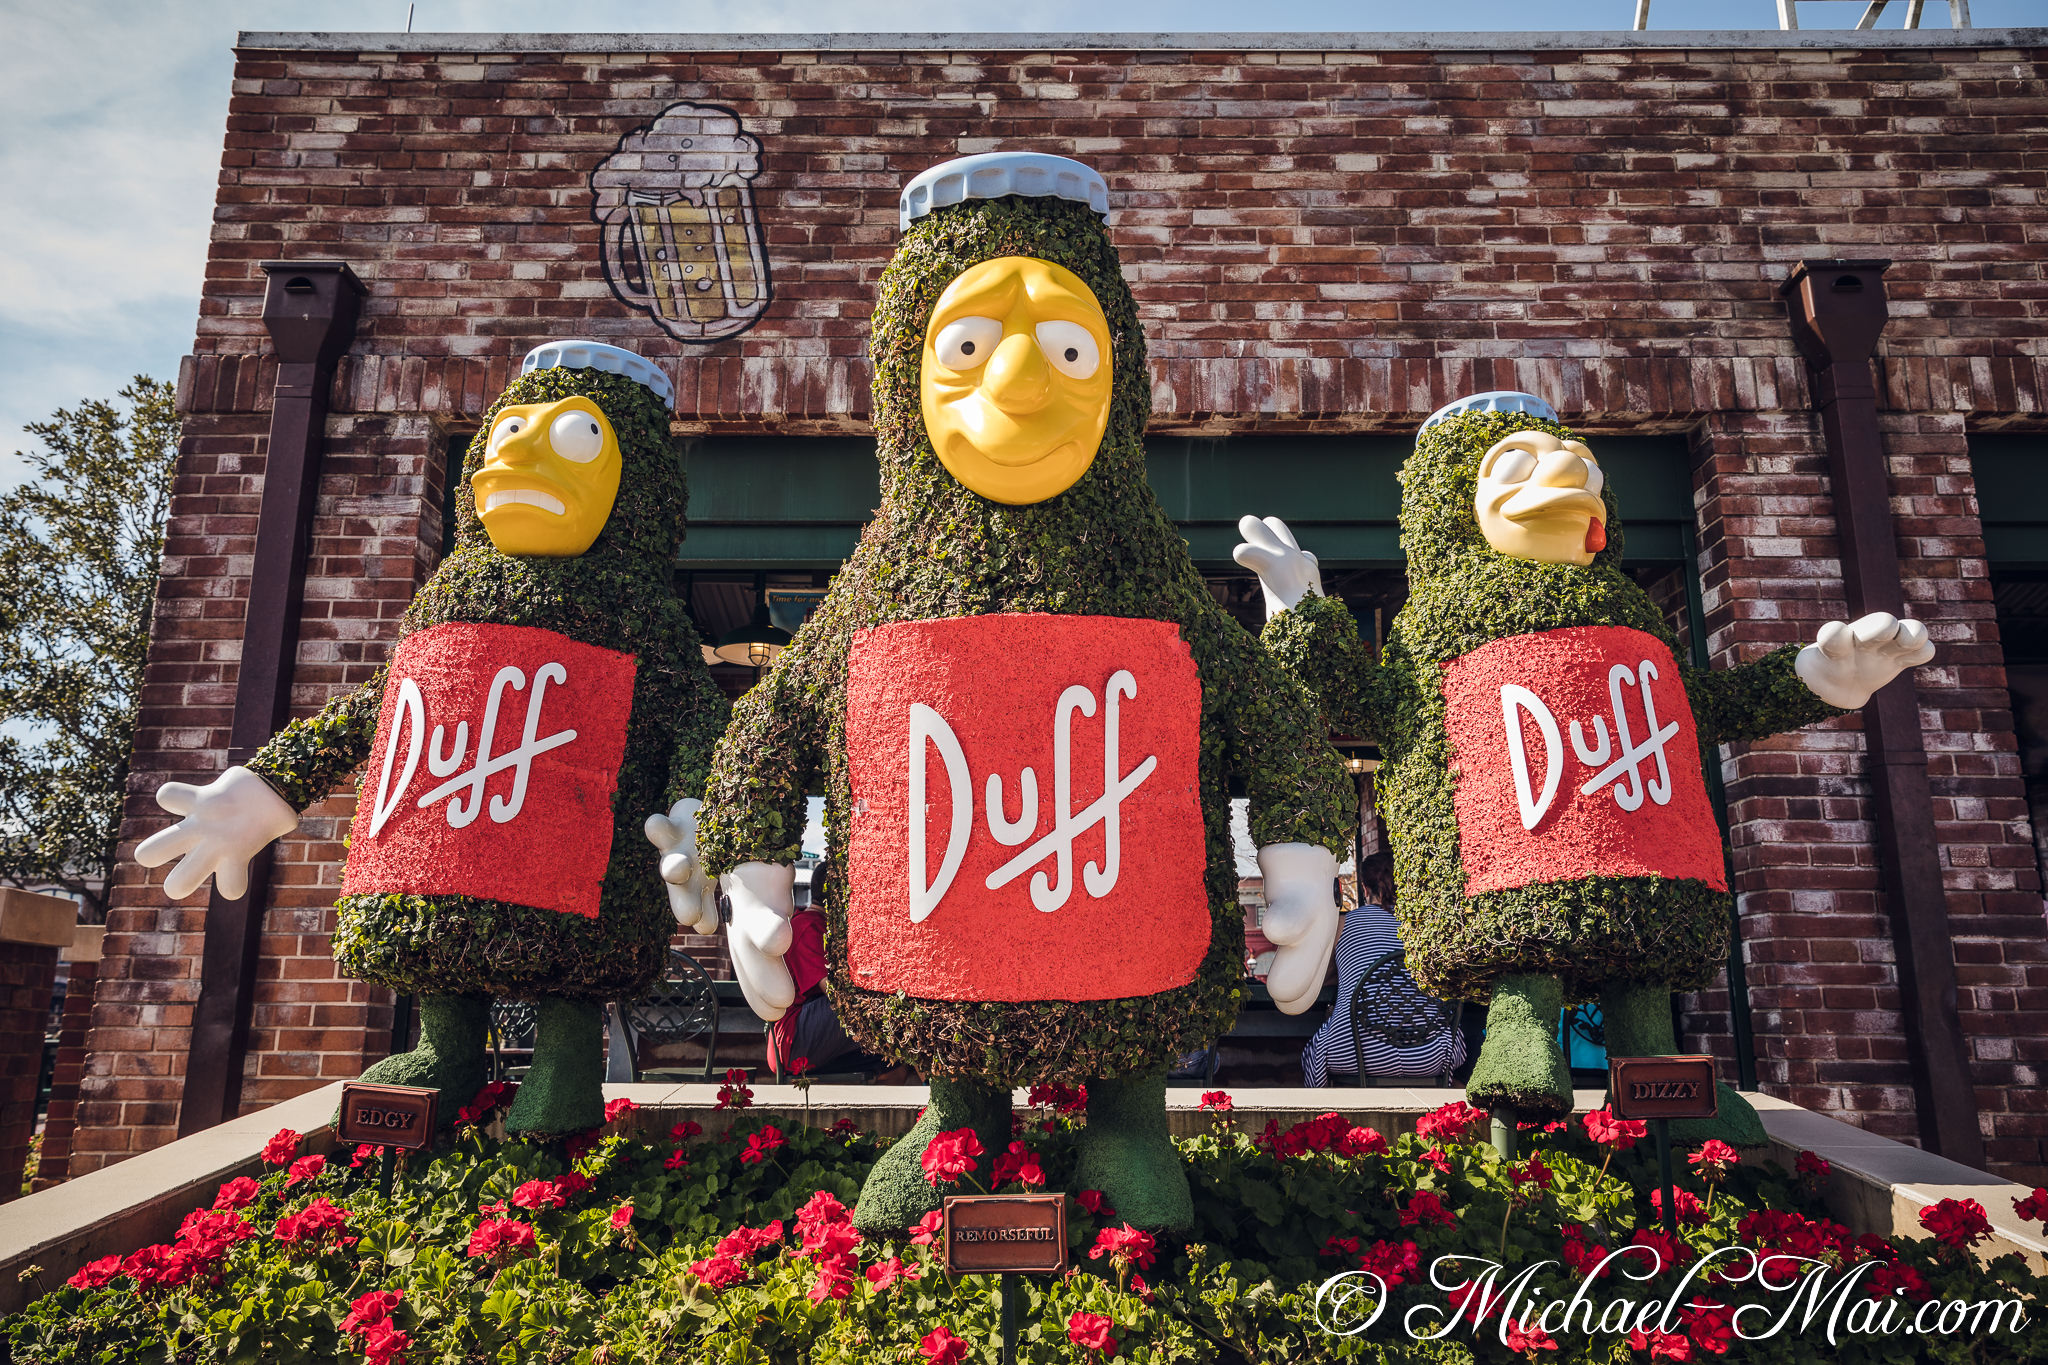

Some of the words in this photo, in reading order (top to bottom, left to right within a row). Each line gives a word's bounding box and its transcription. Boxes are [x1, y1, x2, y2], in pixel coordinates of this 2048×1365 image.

[369, 662, 578, 839] Duff
[1500, 659, 1680, 832] Duff
[908, 669, 1156, 924] Duff
[356, 1109, 413, 1128] EDGY
[1633, 1082, 1700, 1099] DIZZY
[955, 1228, 1054, 1241] REMORSEFUL
